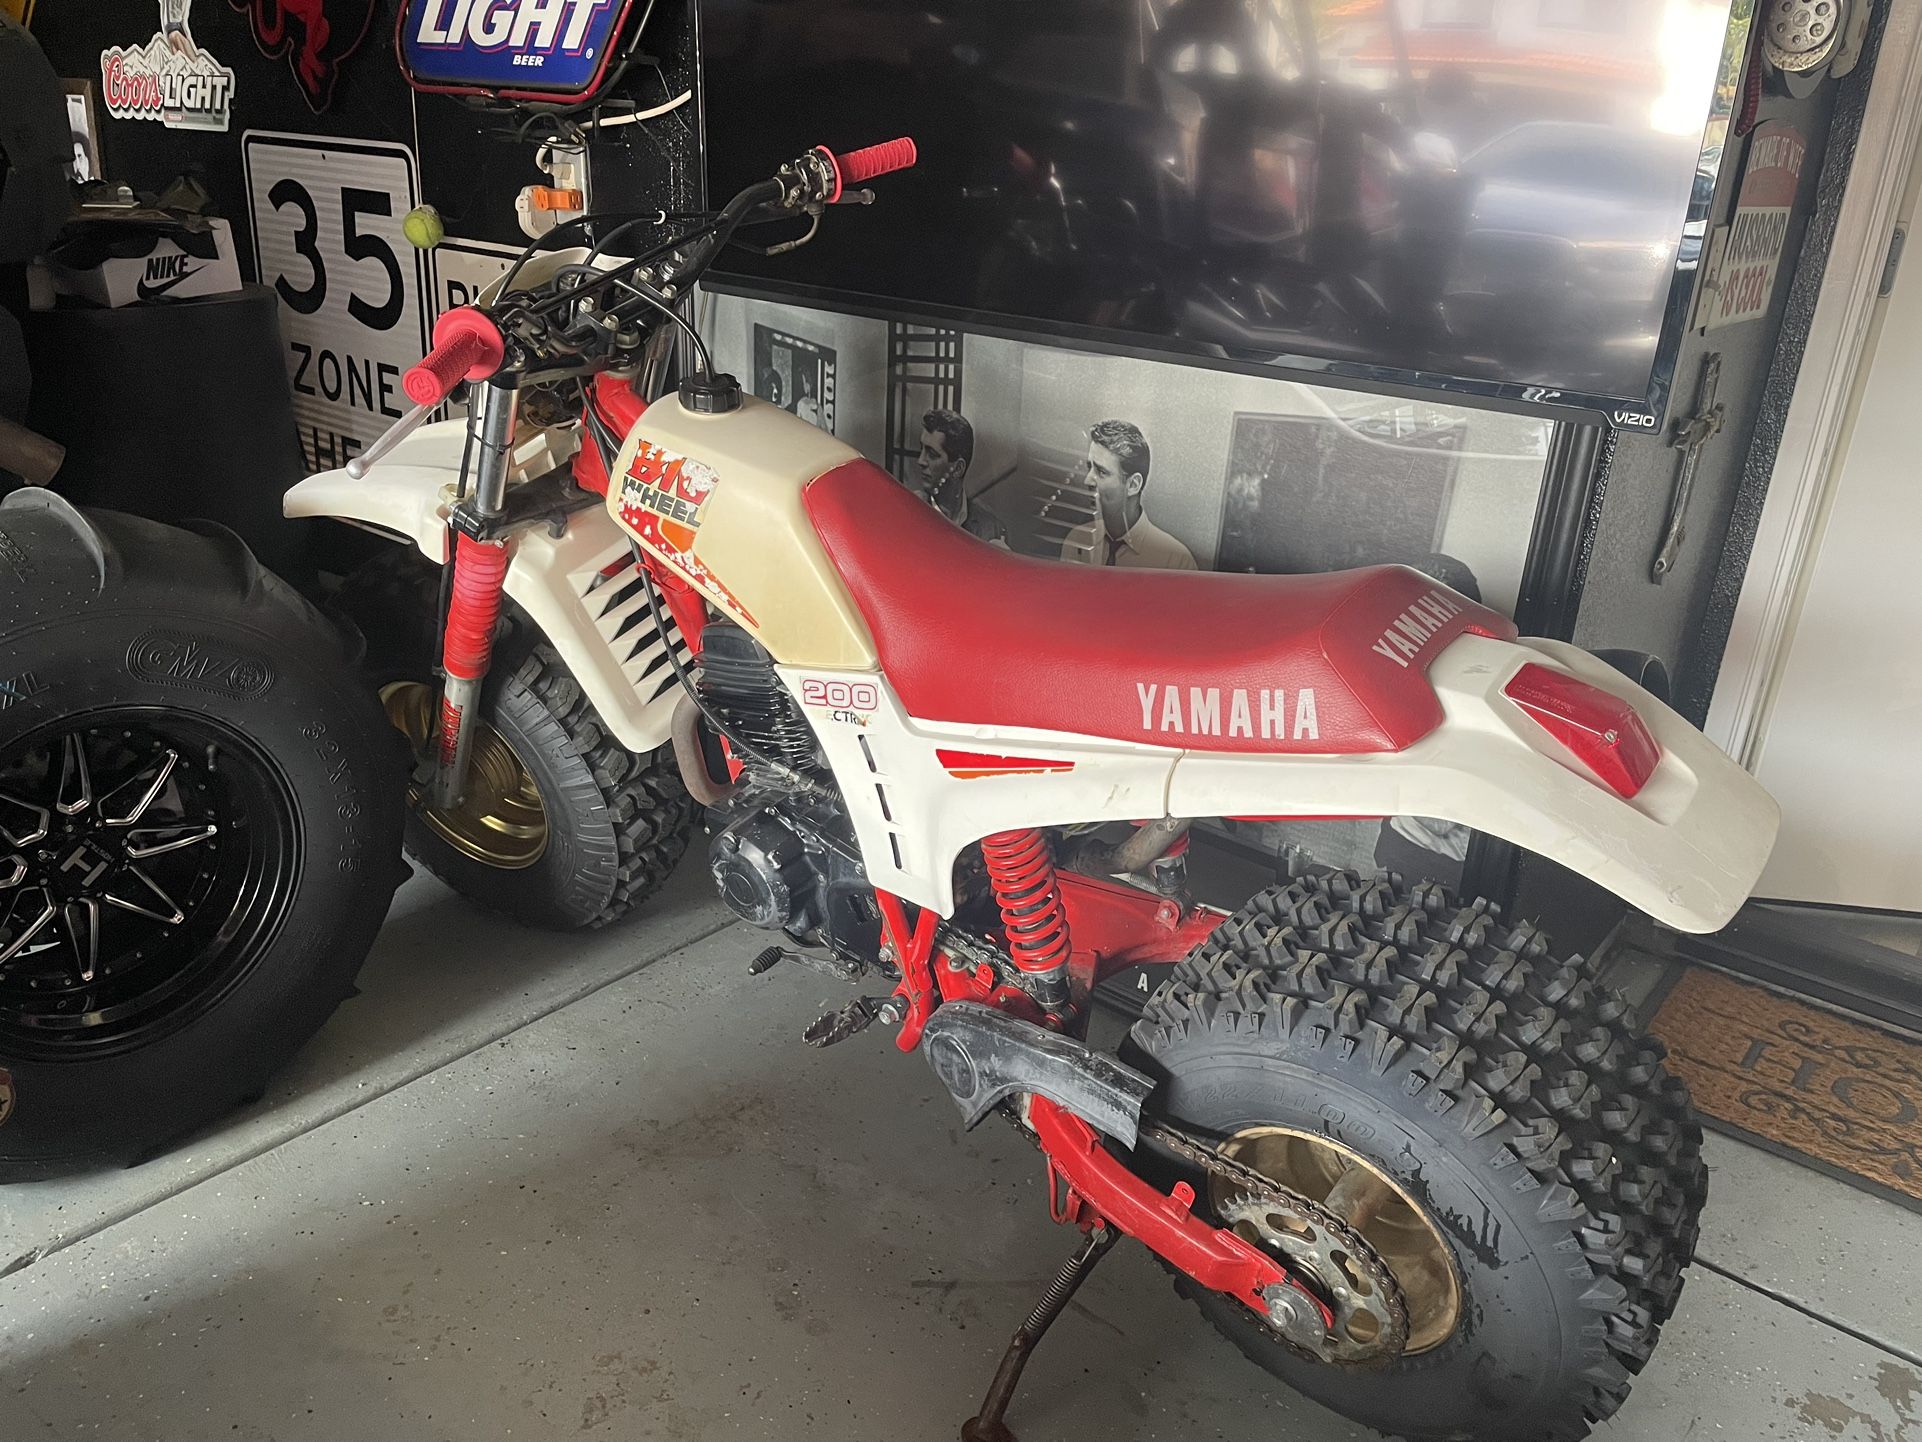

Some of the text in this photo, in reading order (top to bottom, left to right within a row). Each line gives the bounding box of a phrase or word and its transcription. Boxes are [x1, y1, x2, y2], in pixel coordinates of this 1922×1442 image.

[416, 0, 606, 49] LIGHT
[104, 54, 229, 111] Coors LIGHT
[512, 54, 545, 67] BEER
[267, 178, 405, 331] 35
[1727, 212, 1788, 265] HUSBAND
[145, 254, 189, 281] NIKE
[1720, 264, 1769, 318] IS COOL
[290, 341, 403, 419] ZONE
[1613, 410, 1655, 428] VIZIO
[623, 475, 702, 528] WHEEL
[1371, 590, 1463, 668] YAMAHA
[802, 679, 878, 711] 200
[1136, 682, 1320, 741] YAMAHA
